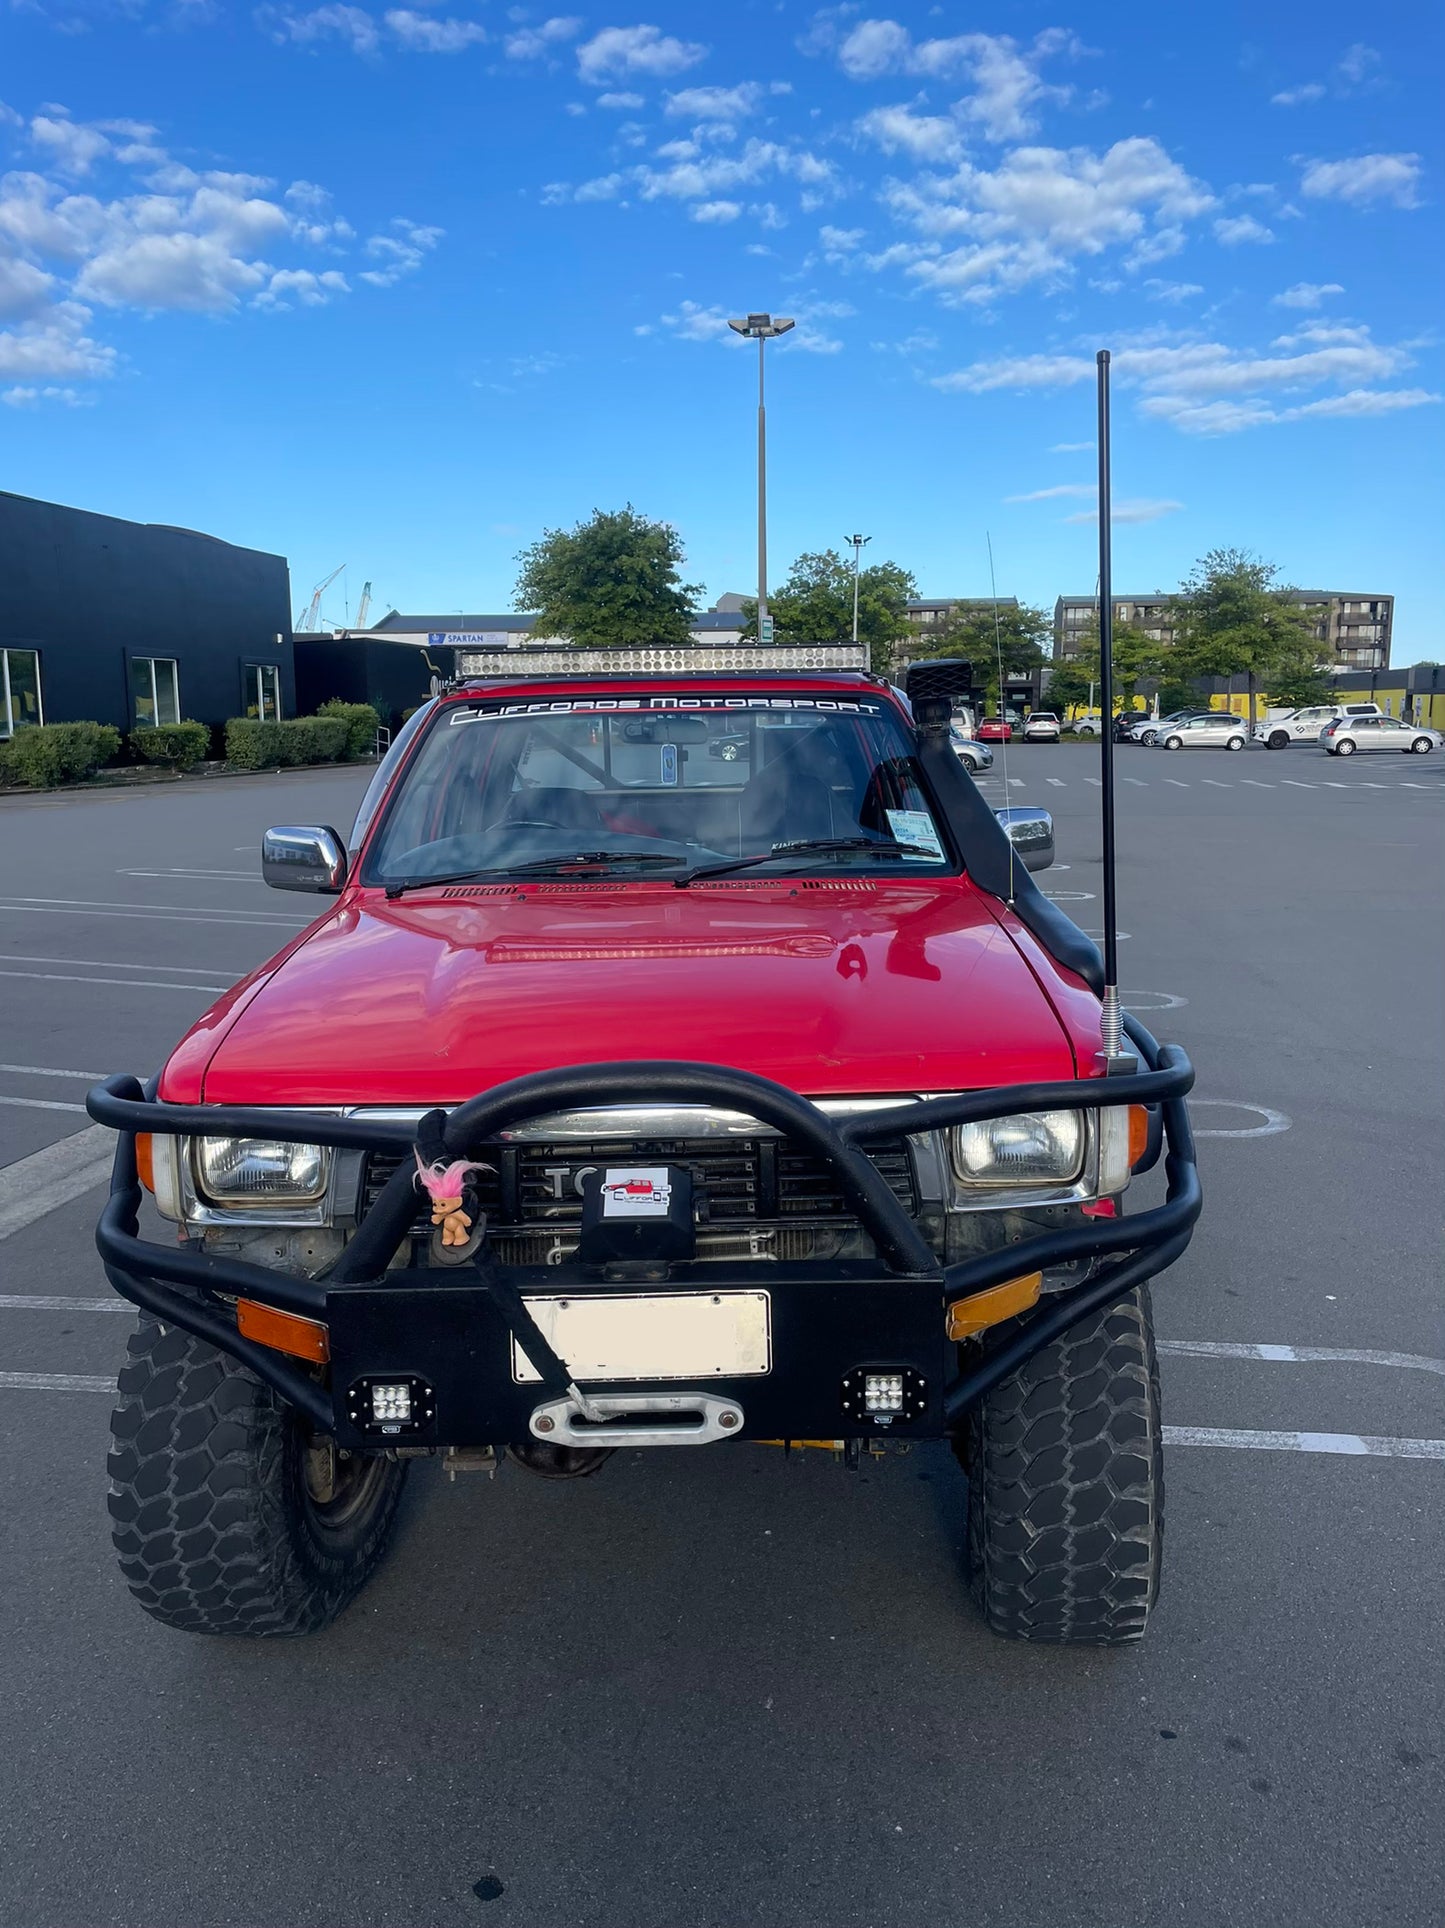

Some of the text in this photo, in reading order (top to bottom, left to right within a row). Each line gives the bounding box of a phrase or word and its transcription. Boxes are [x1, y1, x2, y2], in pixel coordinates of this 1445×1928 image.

[447, 634, 484, 643] SPARTAN
[450, 698, 880, 725] CLIFFORDS MOTORSPORT
